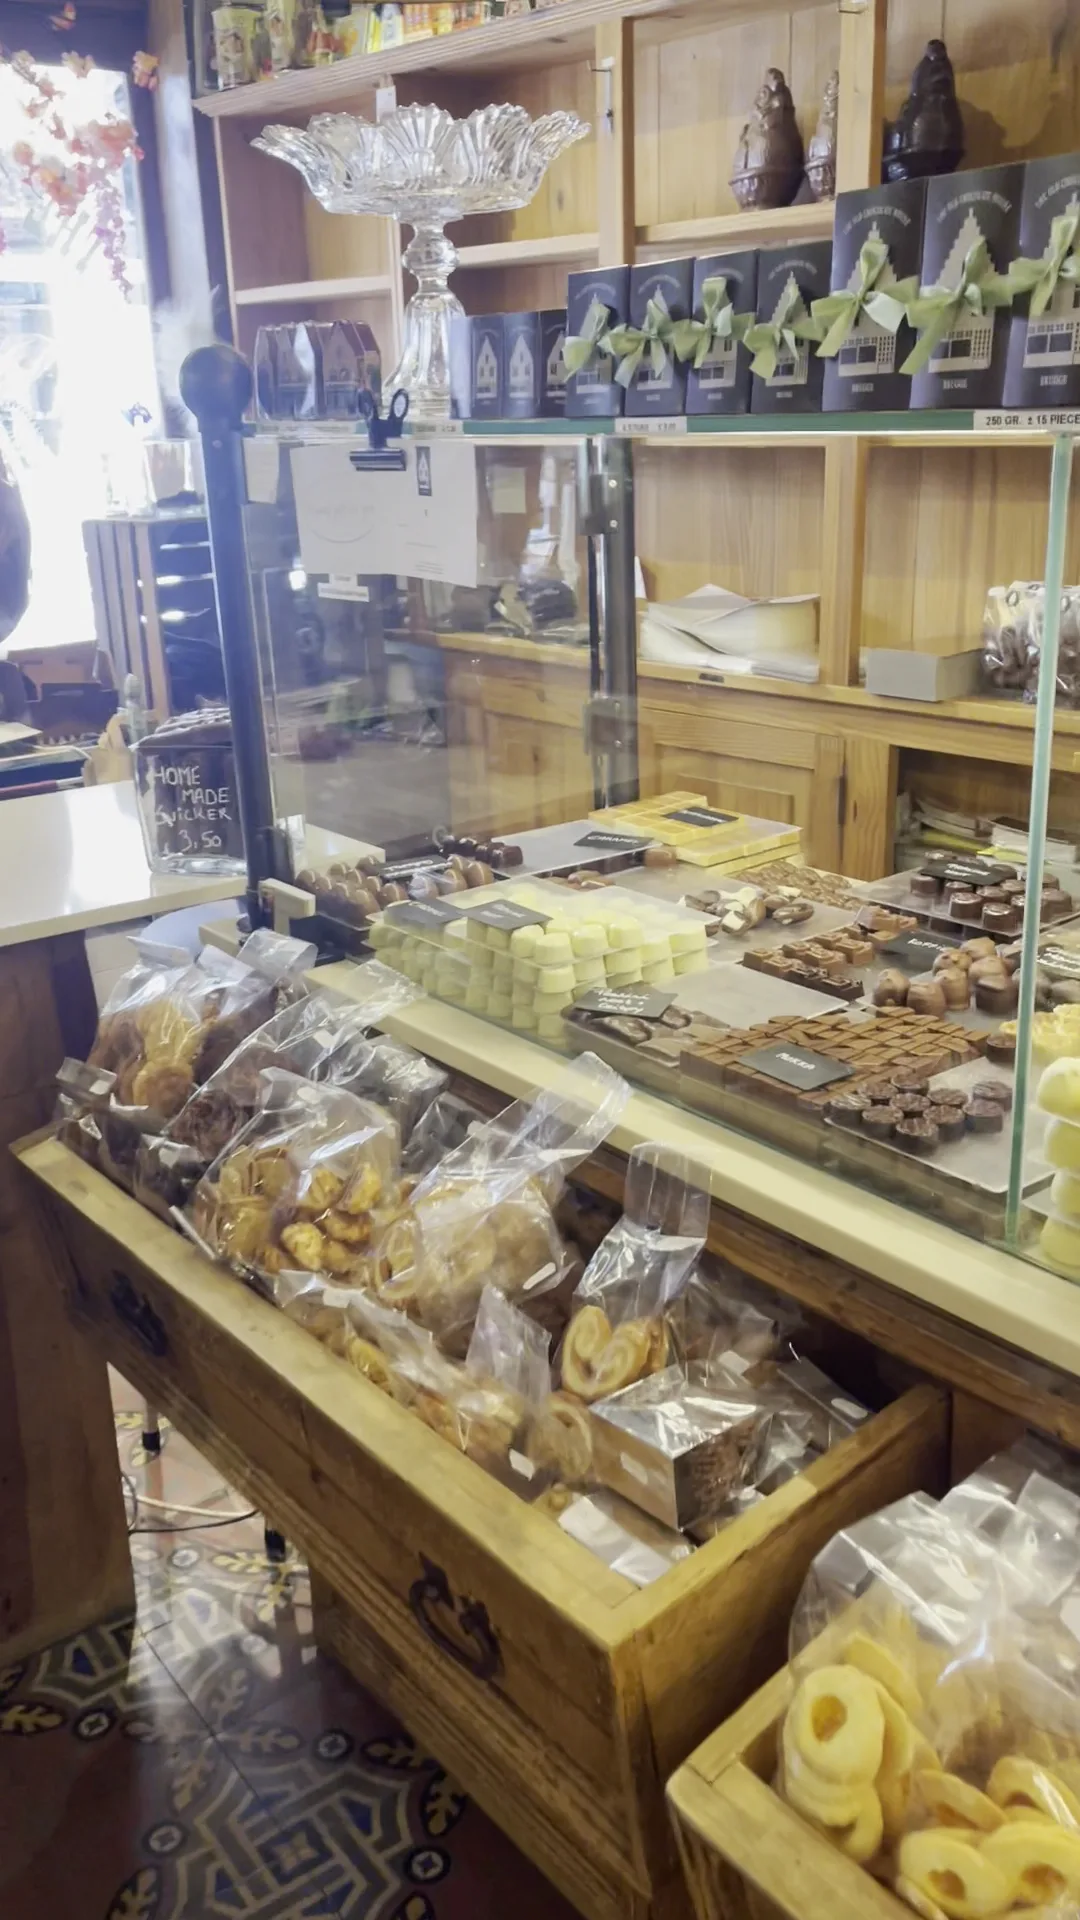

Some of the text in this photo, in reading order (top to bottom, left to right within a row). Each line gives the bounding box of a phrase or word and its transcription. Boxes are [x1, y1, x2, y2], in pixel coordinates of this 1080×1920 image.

[985, 415, 1002, 426] 250
[1036, 414, 1048, 425] 15
[152, 765, 200, 786] HOME
[182, 787, 230, 805] MADE
